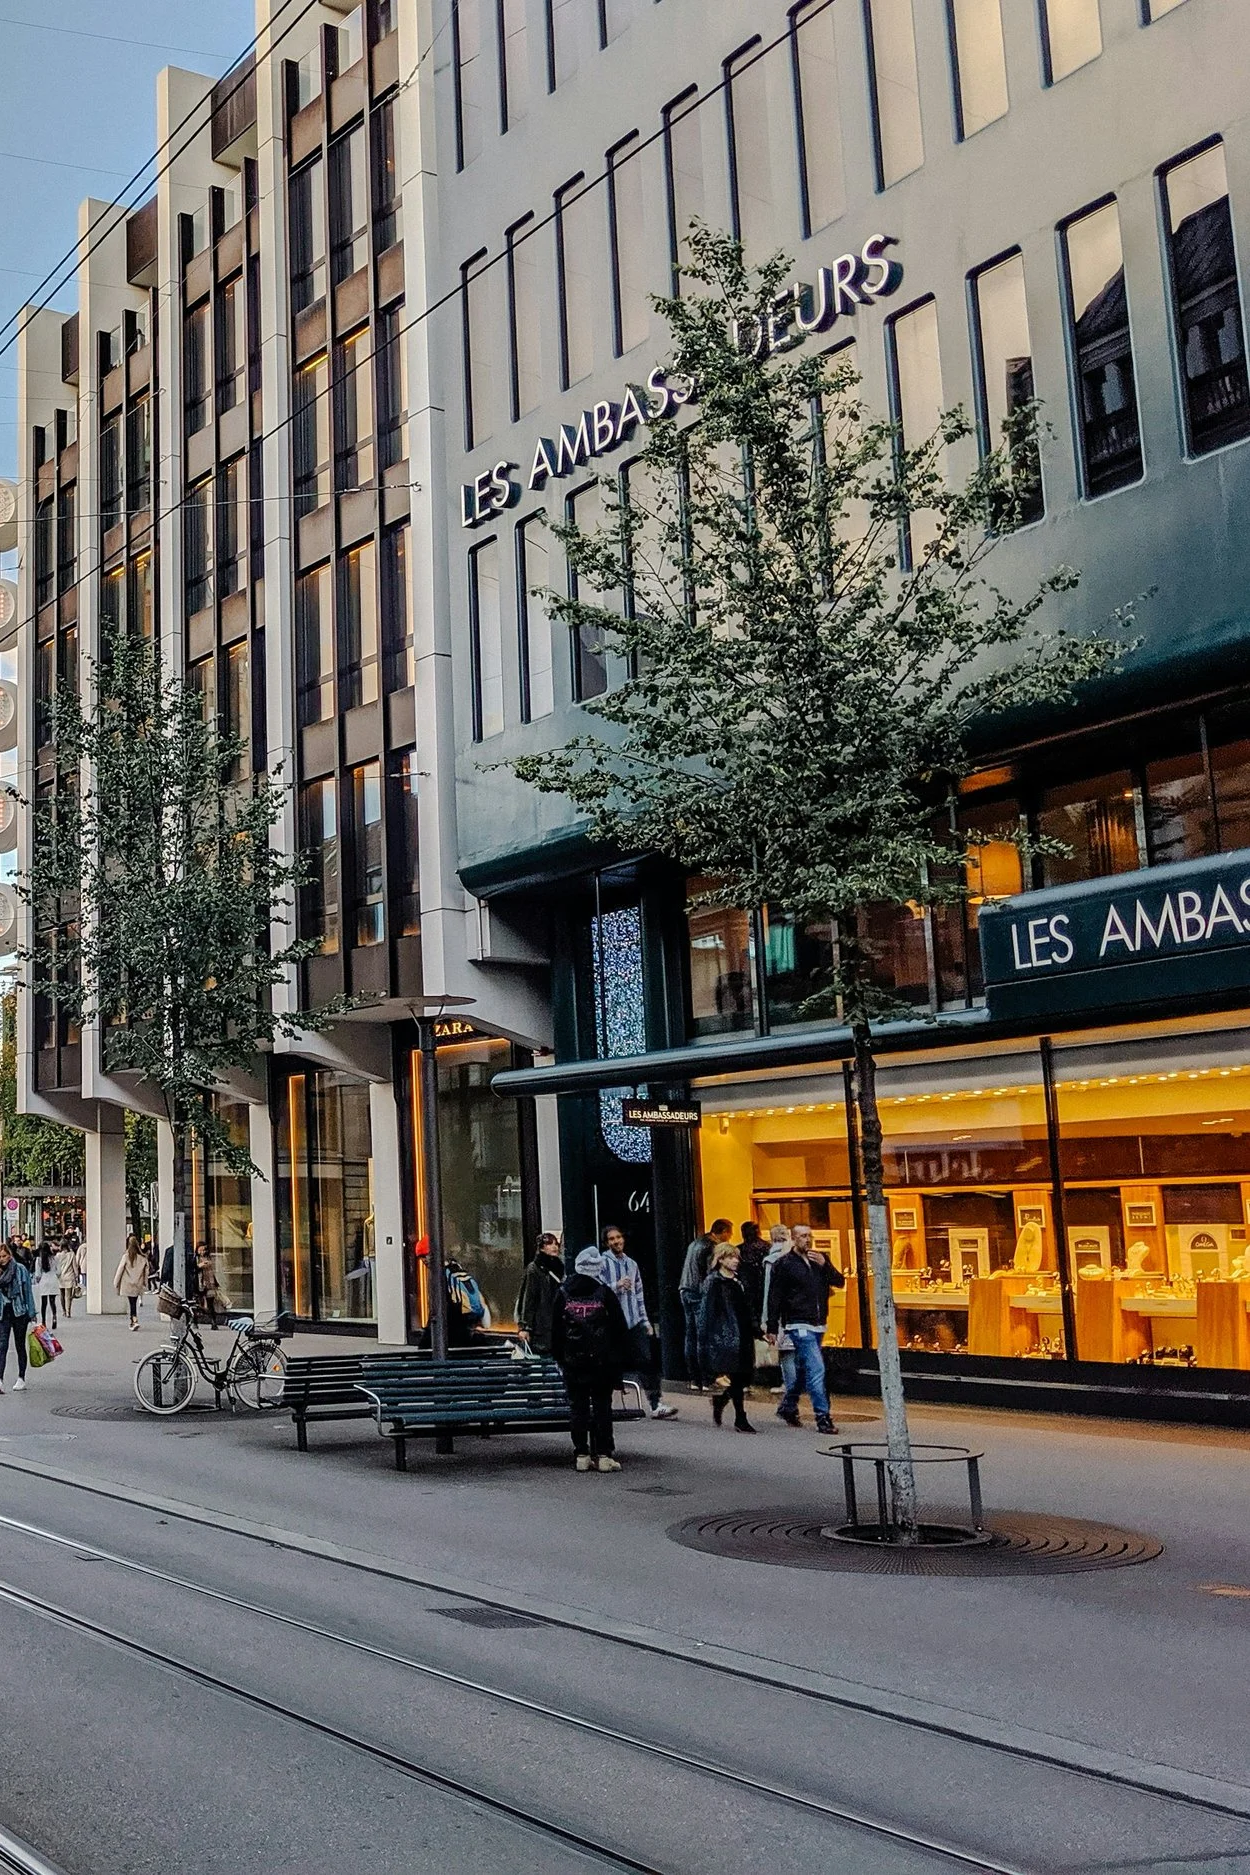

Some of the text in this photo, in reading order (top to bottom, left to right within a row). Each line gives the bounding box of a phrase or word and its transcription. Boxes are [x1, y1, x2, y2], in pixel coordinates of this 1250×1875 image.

[460, 233, 897, 528] LES AMBASSDEURS
[1011, 914, 1074, 970] LES
[434, 1022, 474, 1037] ZARA
[629, 1110, 698, 1120] LES AMBASSADEURS
[628, 1190, 650, 1213] 64
